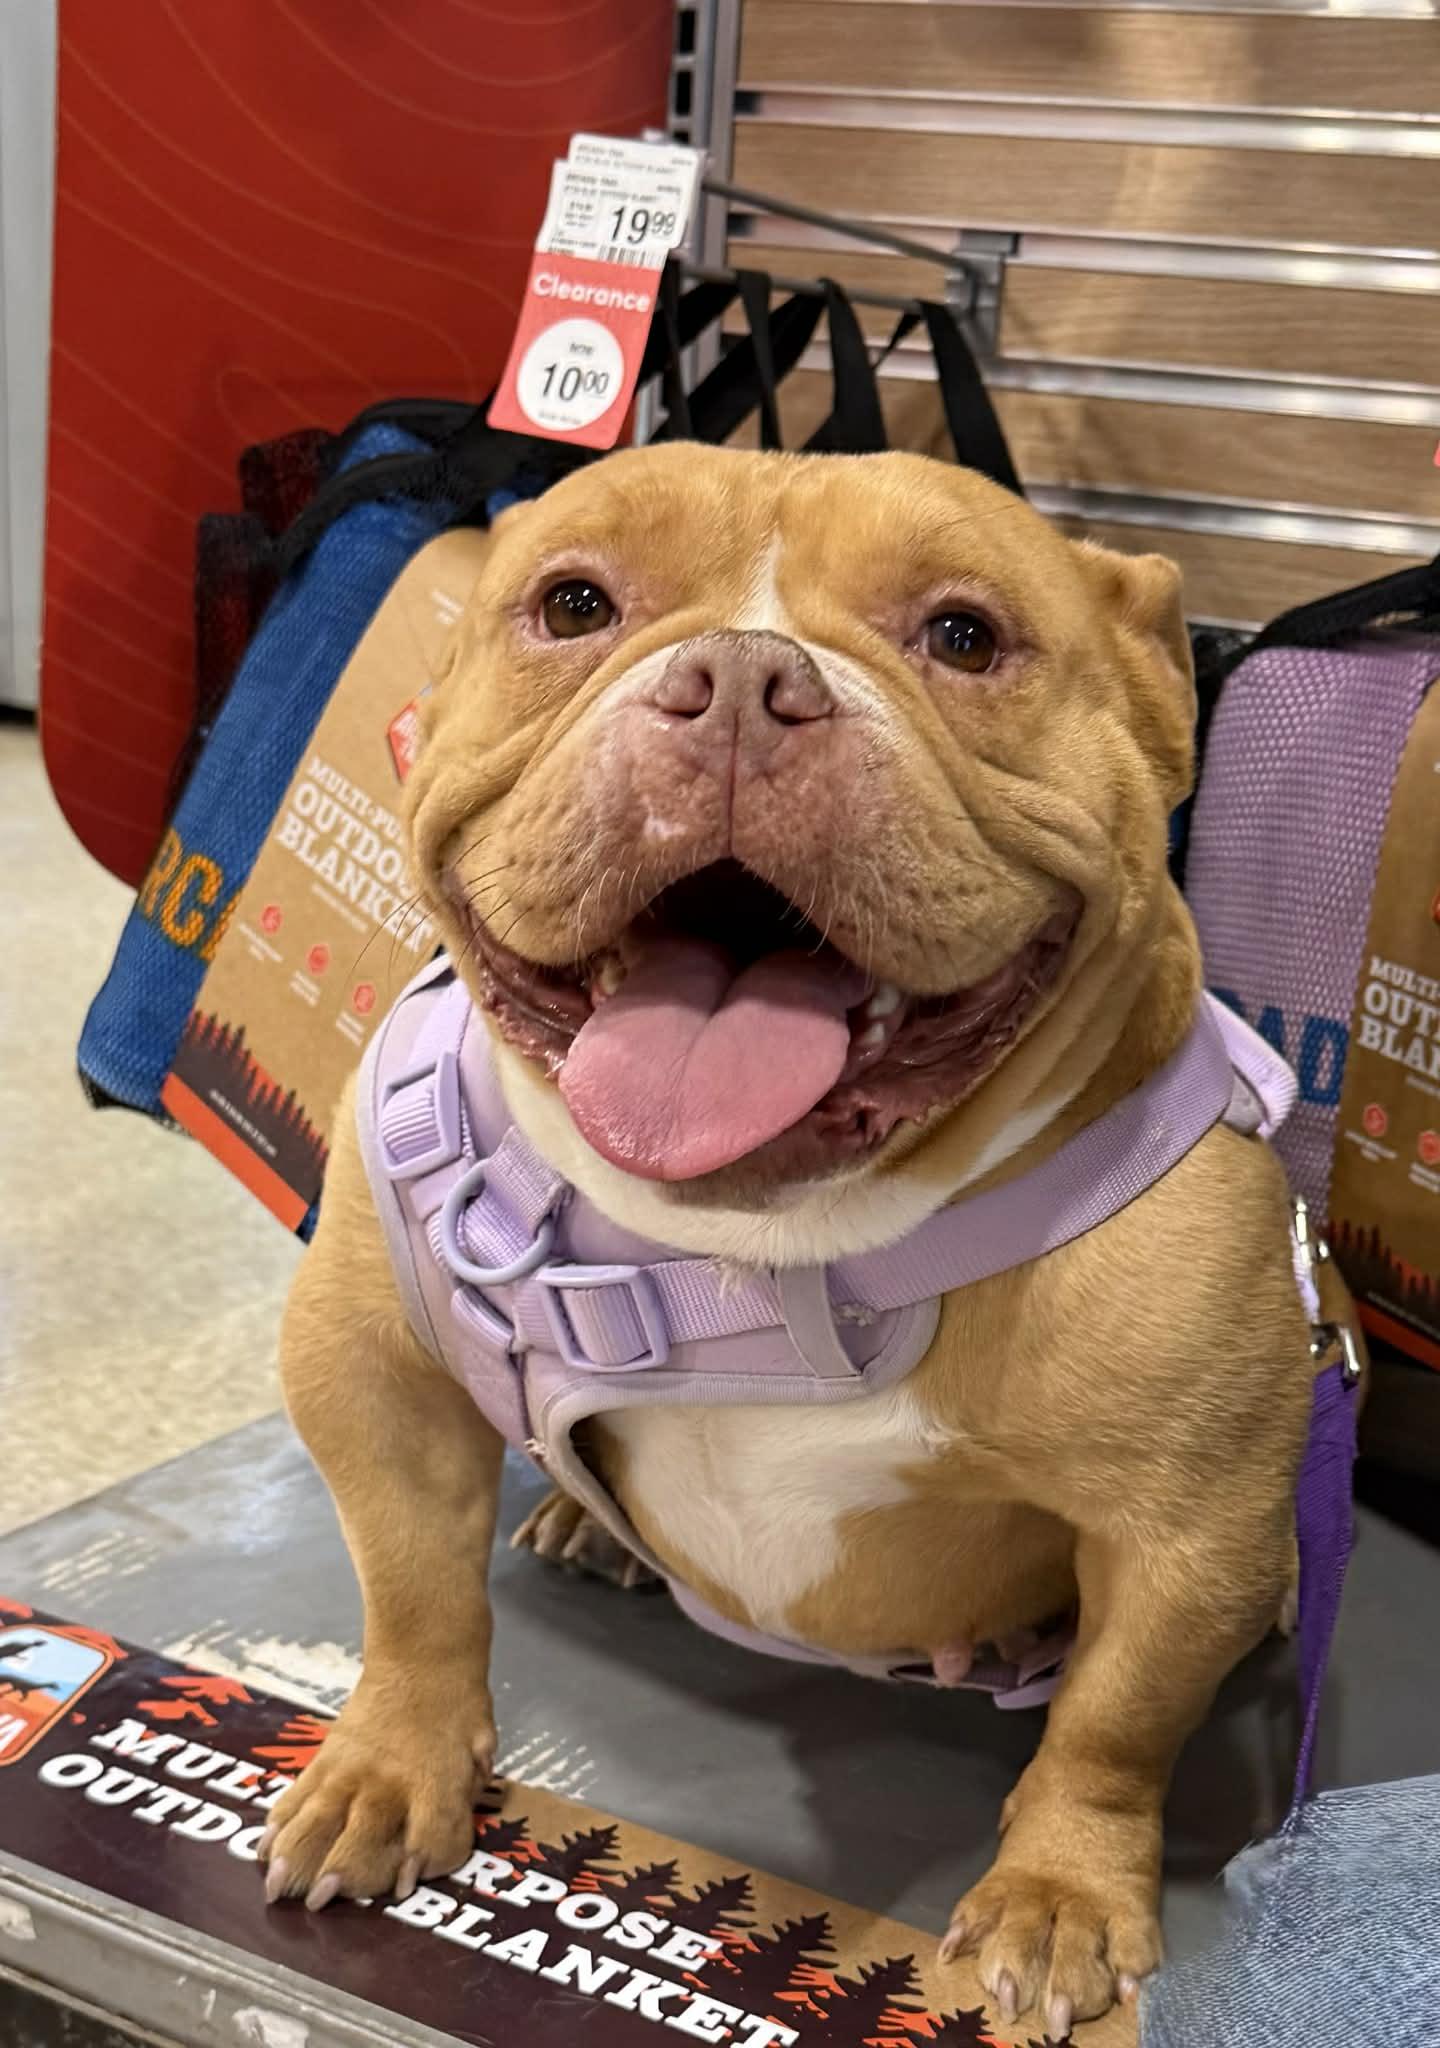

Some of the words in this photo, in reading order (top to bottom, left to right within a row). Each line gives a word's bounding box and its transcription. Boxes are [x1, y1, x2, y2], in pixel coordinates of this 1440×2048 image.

[533, 272, 650, 312] Clearance
[307, 756, 403, 846] MULTI-PU
[275, 812, 433, 952] BLANKET
[1364, 981, 1440, 1044] OUT
[384, 1886, 799, 2048] BLANKET
